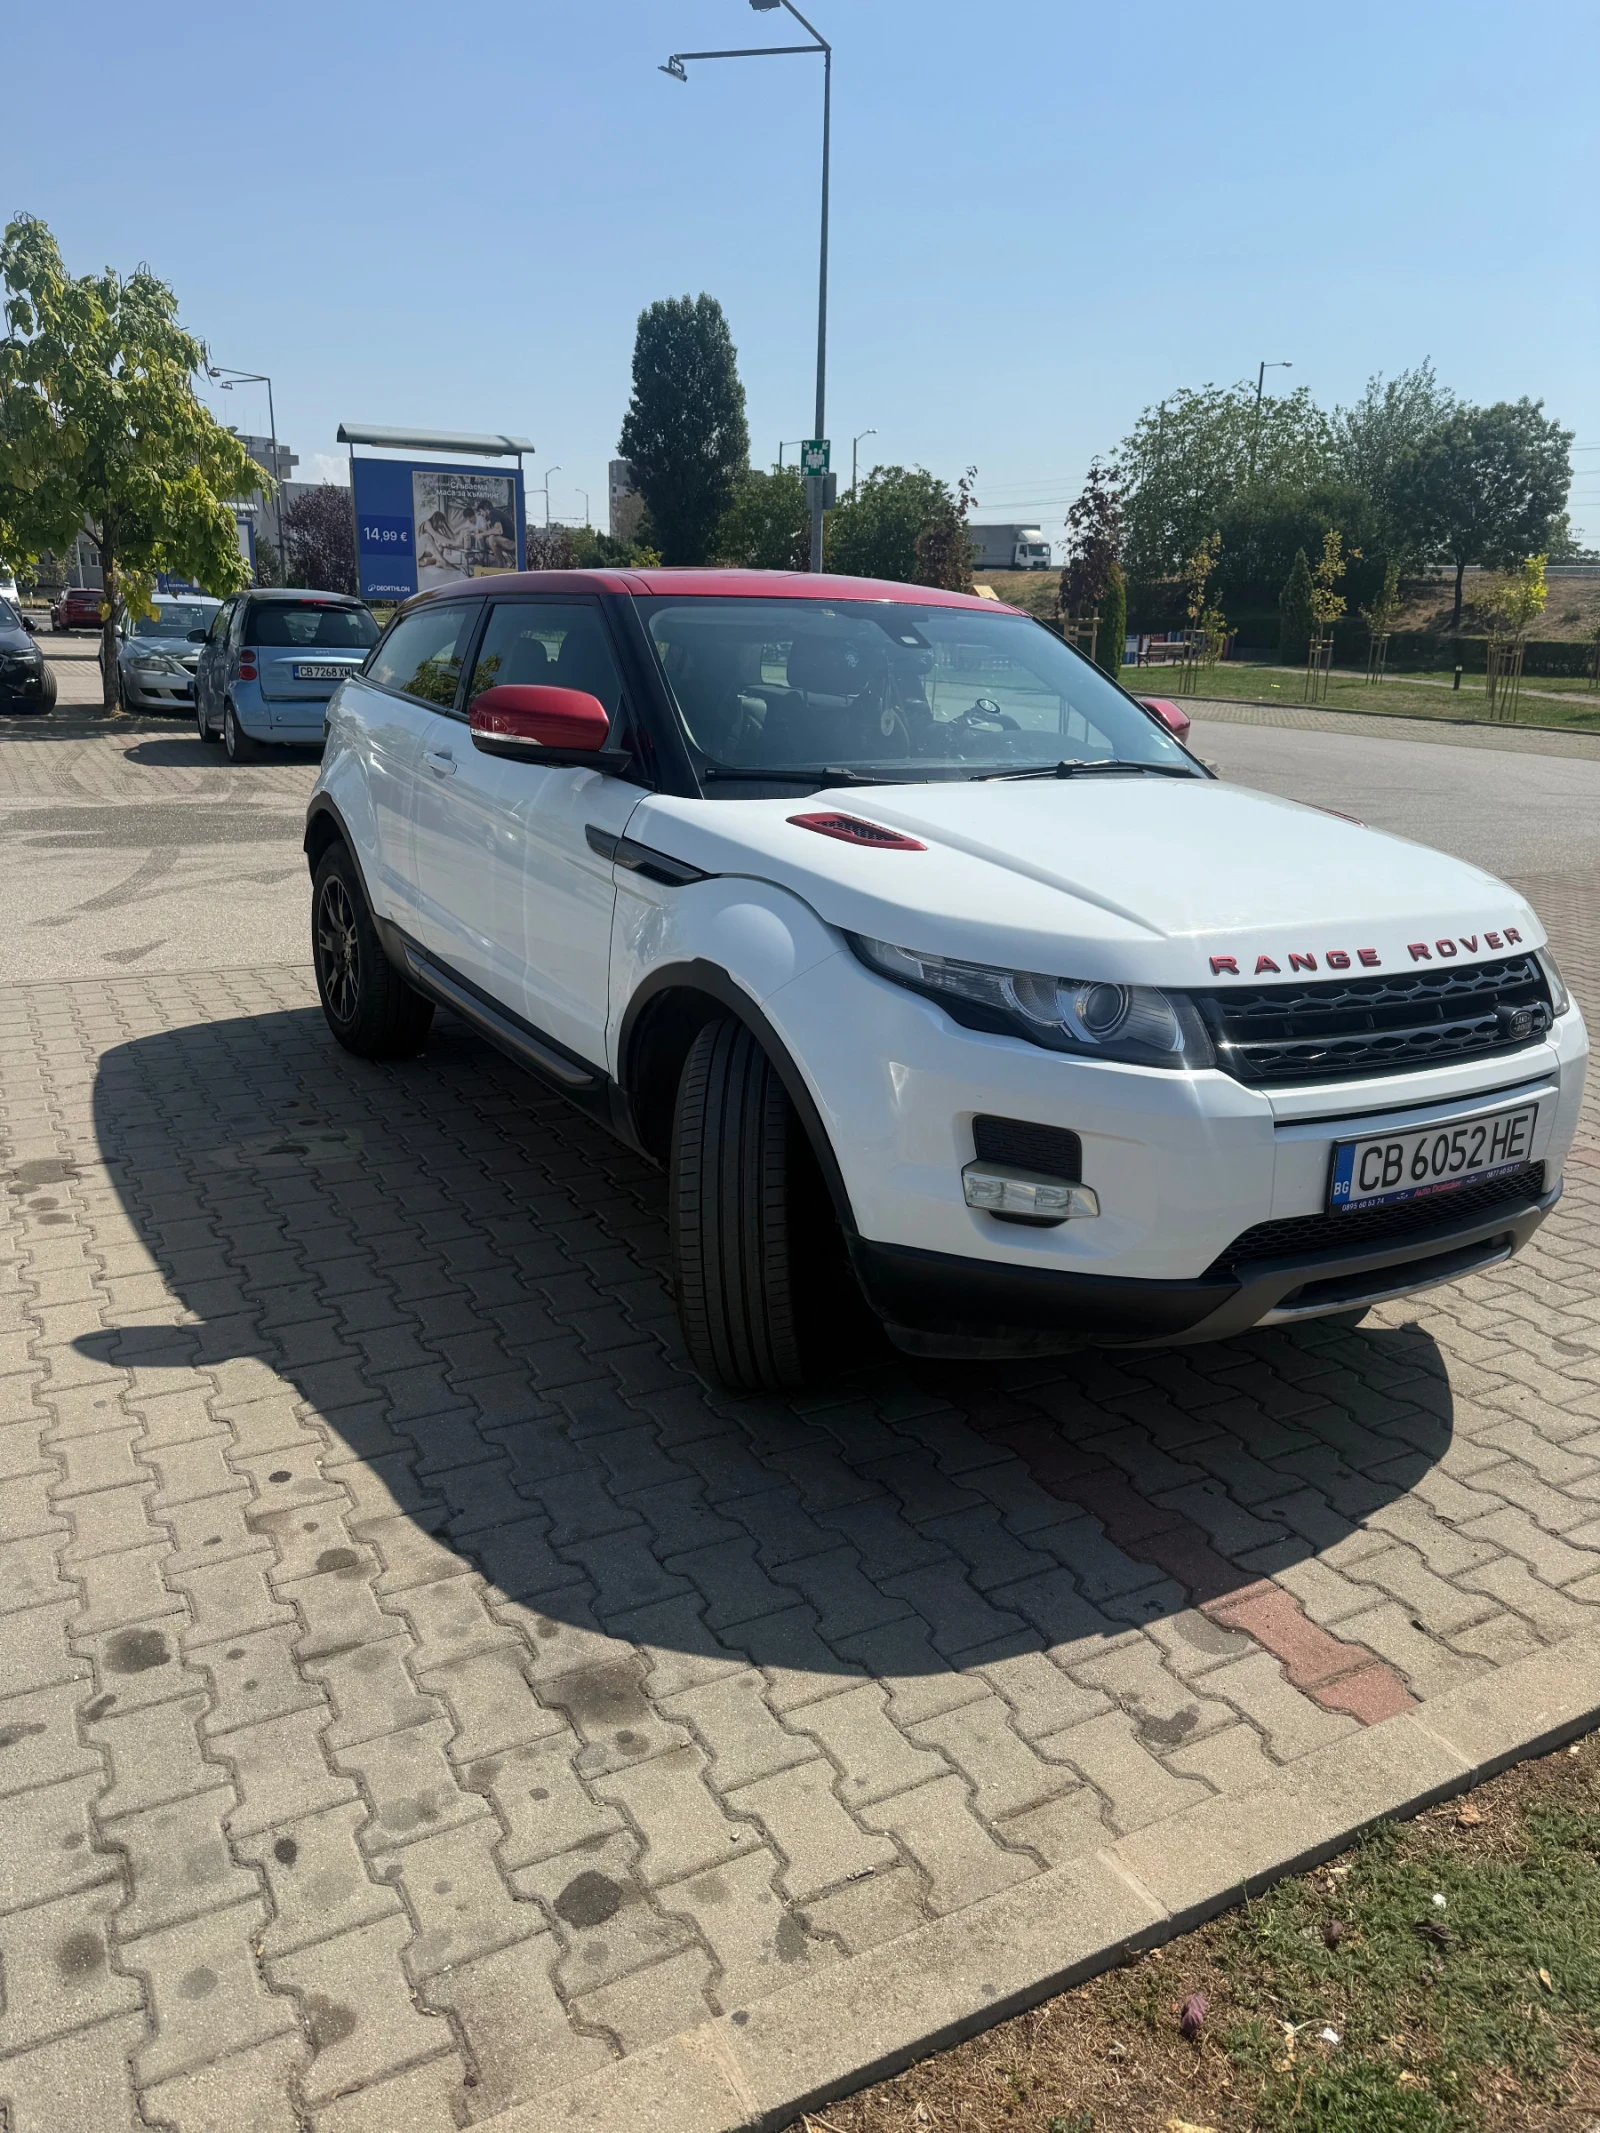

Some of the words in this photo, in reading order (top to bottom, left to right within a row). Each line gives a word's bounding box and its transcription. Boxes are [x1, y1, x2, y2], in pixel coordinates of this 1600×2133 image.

[467, 491, 500, 499] къмпинг
[363, 527, 397, 542] 14,99
[400, 531, 408, 542] €
[300, 667, 313, 677] CB
[314, 667, 338, 677] 7268
[1209, 948, 1382, 976] RANGE
[1407, 927, 1523, 962] ROVER
[1359, 1143, 1403, 1192] CB
[1411, 1125, 1487, 1181] 6052
[1489, 1115, 1529, 1163] HE
[1333, 1181, 1349, 1196] BG
[1413, 1187, 1431, 1198] Auto
[1341, 1202, 1358, 1211] 0895
[1358, 1200, 1367, 1209] 60
